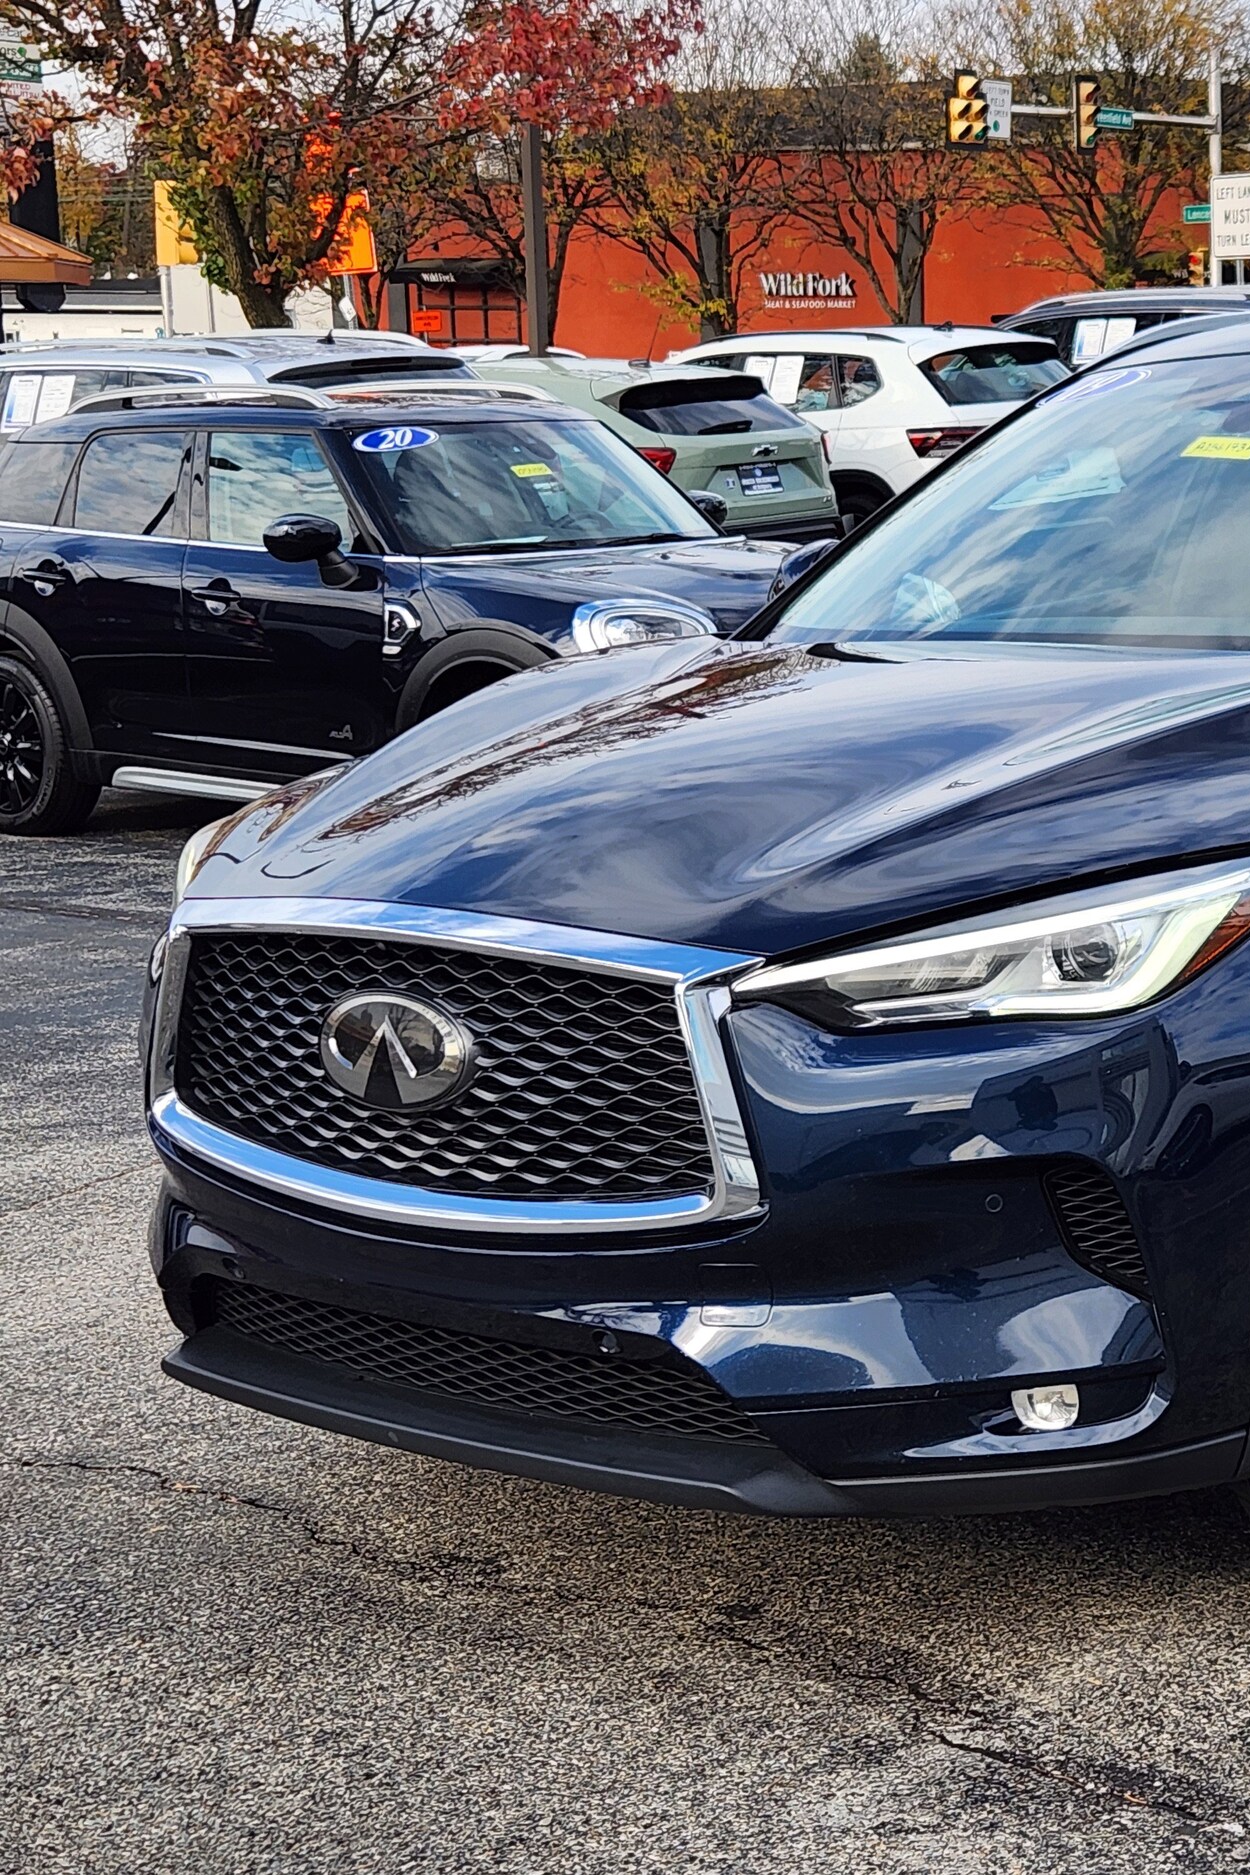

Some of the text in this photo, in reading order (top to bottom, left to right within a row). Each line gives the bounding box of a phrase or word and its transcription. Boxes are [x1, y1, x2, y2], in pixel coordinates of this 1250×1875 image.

[1216, 187, 1234, 200] LEFT
[1224, 209, 1250, 224] MUST
[1217, 234, 1236, 247] TURN
[760, 272, 855, 296] Wild Fork
[765, 300, 856, 308] MEAT & SEAFOOD MARKET
[378, 430, 413, 449] 20
